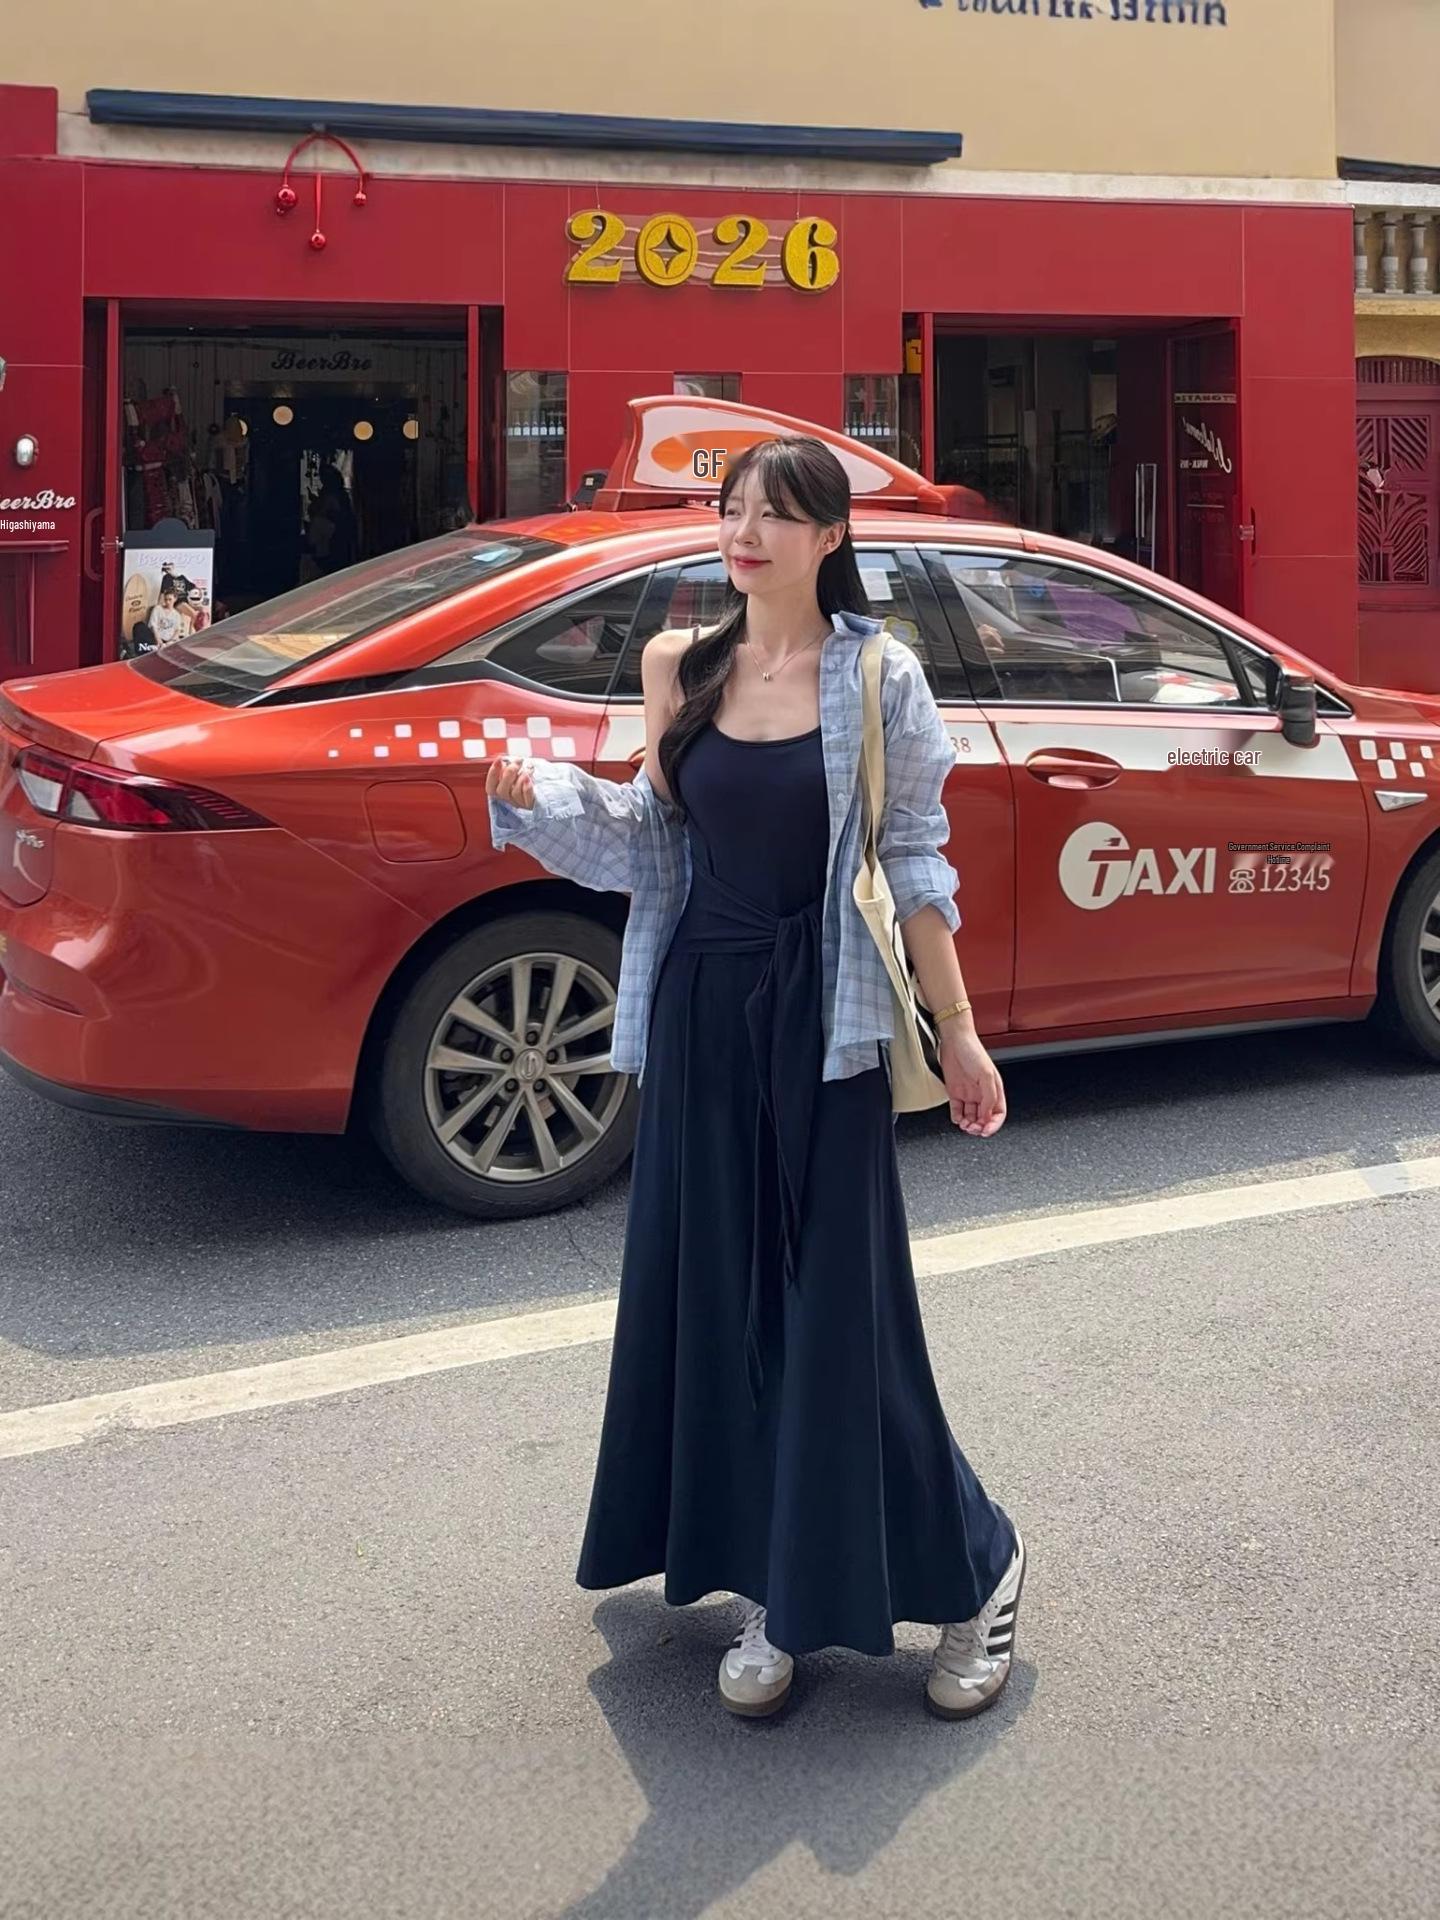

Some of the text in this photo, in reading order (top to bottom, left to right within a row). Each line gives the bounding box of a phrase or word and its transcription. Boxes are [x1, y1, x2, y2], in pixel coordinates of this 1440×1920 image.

[567, 209, 840, 291] 2026
[271, 350, 372, 370] BeerBro
[0, 488, 77, 510] eerBro
[1072, 835, 1217, 902] TAXI
[1260, 865, 1331, 893] 12345
